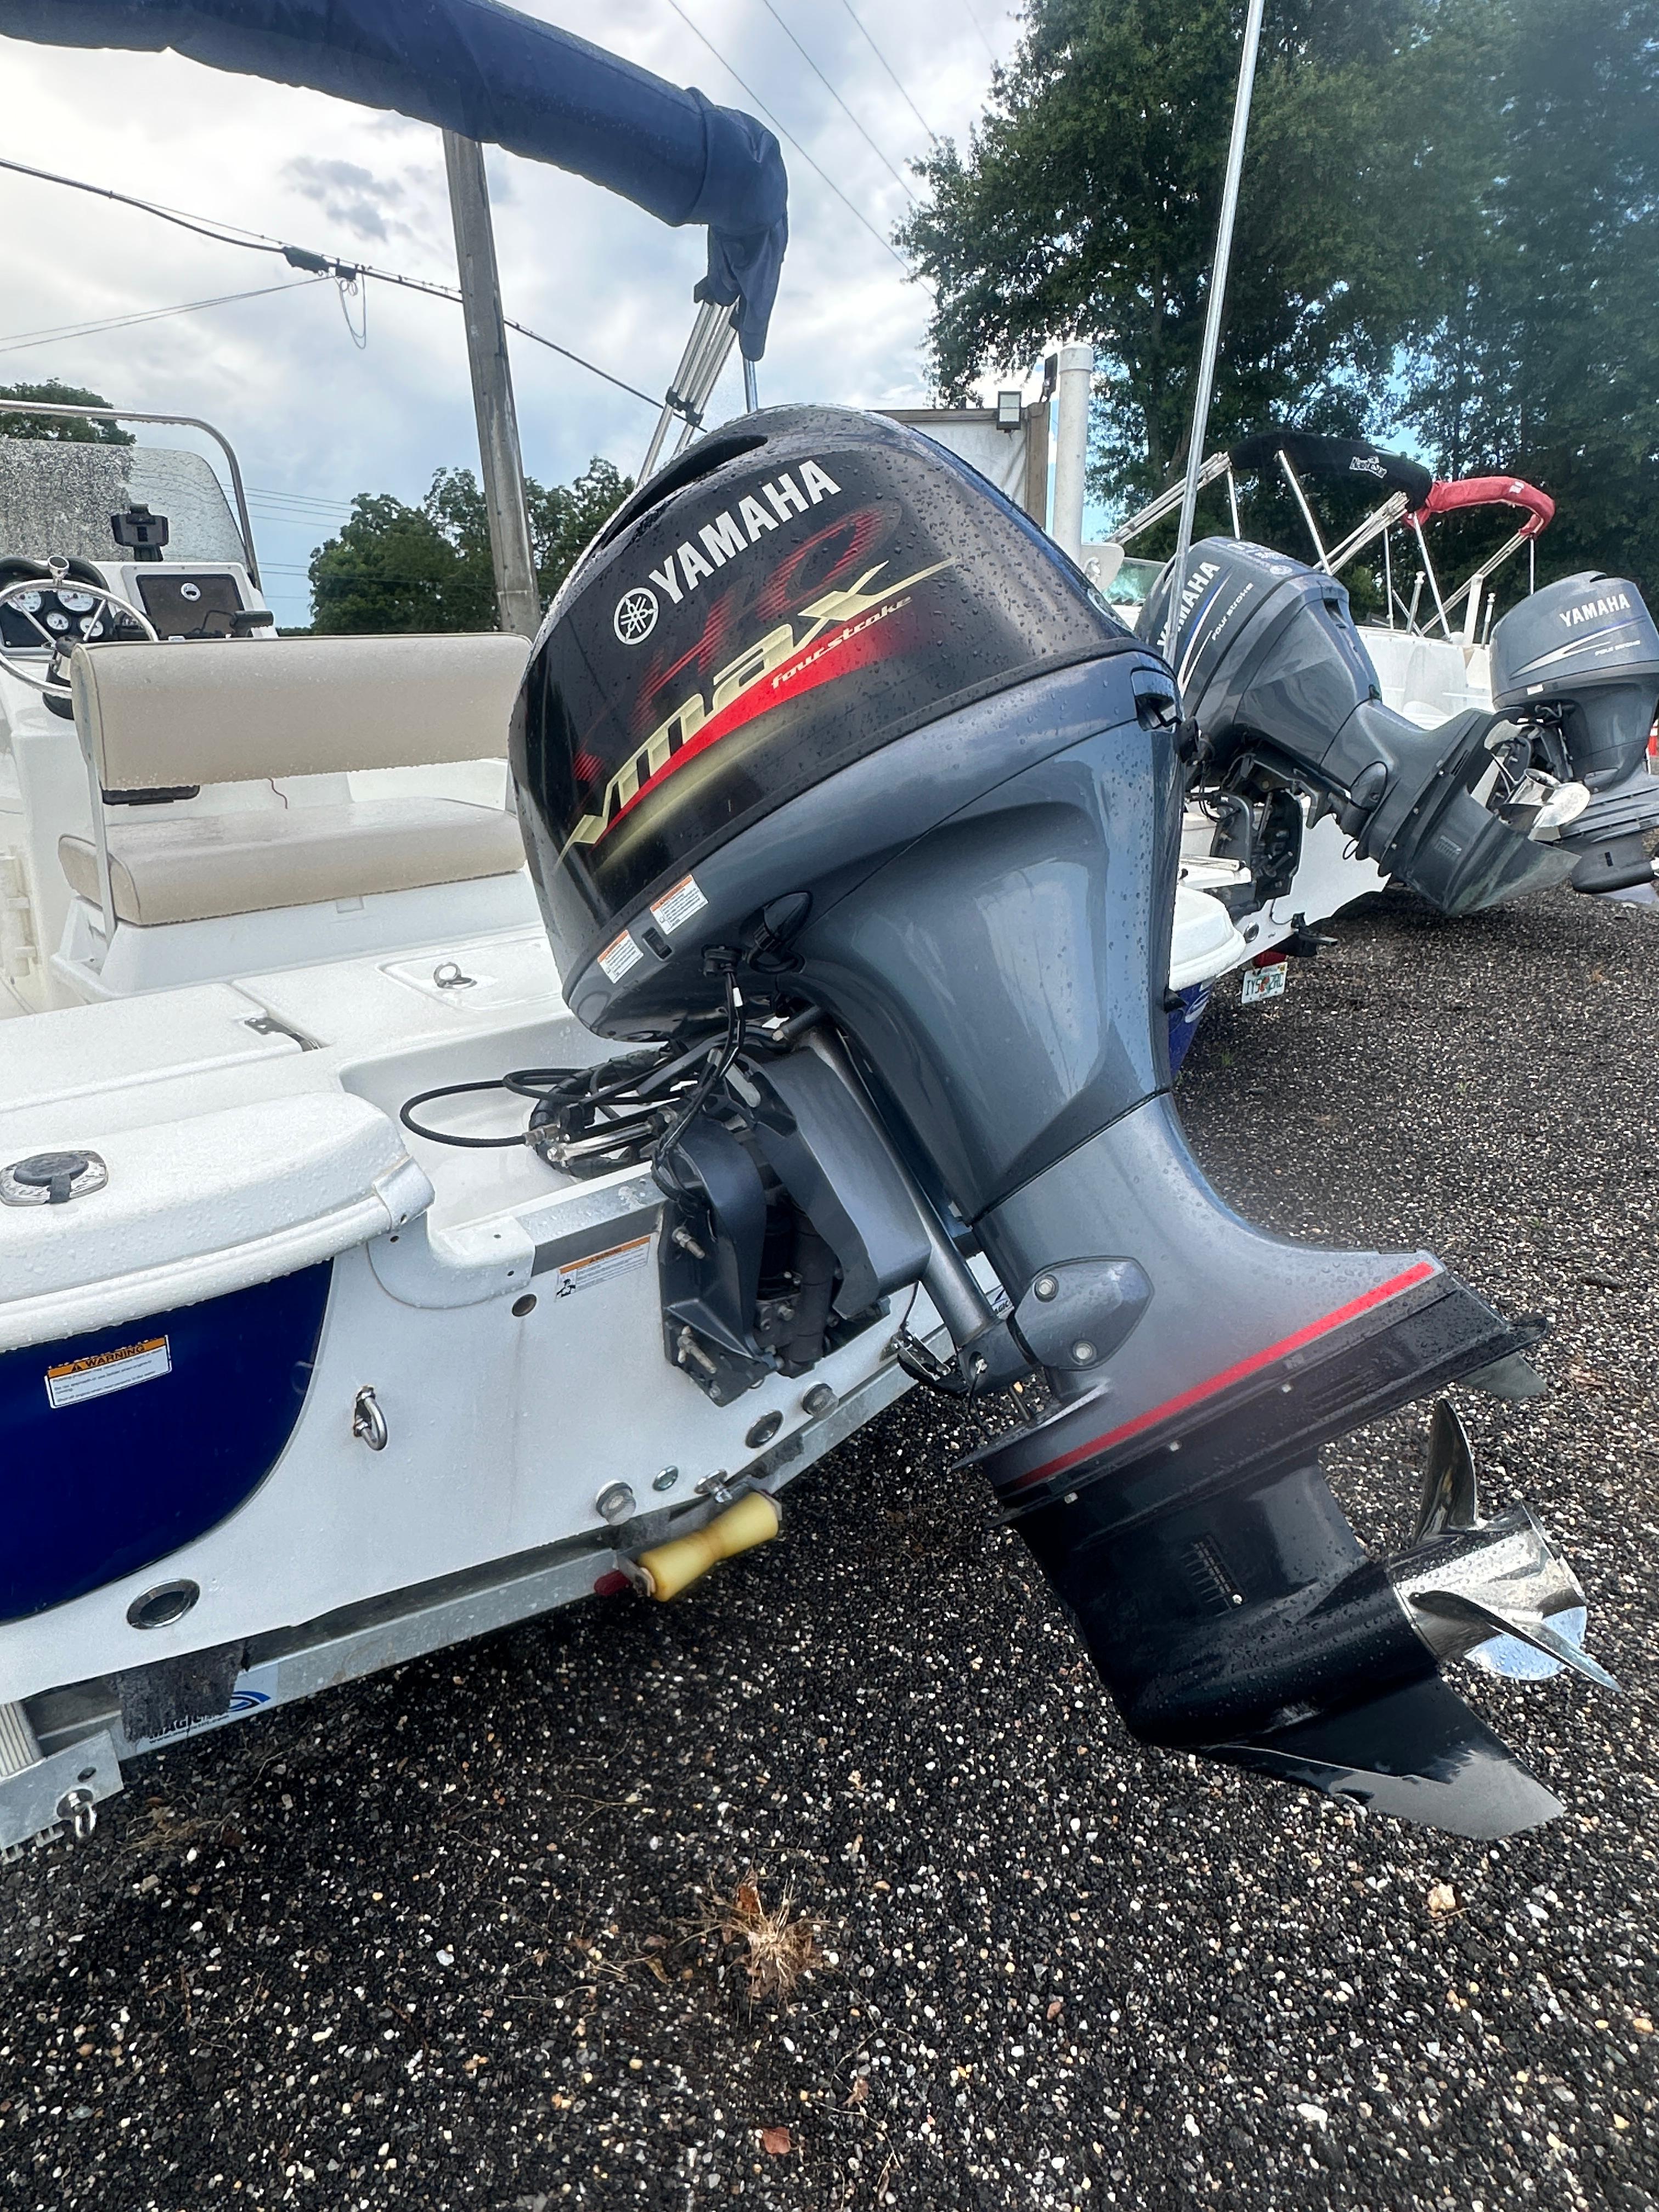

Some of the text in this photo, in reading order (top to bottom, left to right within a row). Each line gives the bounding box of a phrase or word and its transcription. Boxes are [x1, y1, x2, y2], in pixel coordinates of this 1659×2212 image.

[648, 459, 841, 605] YAMAHA
[1156, 562, 1221, 646] YMAHA
[1559, 594, 1630, 627] YAMAHA
[86, 1345, 145, 1367] WARNING
